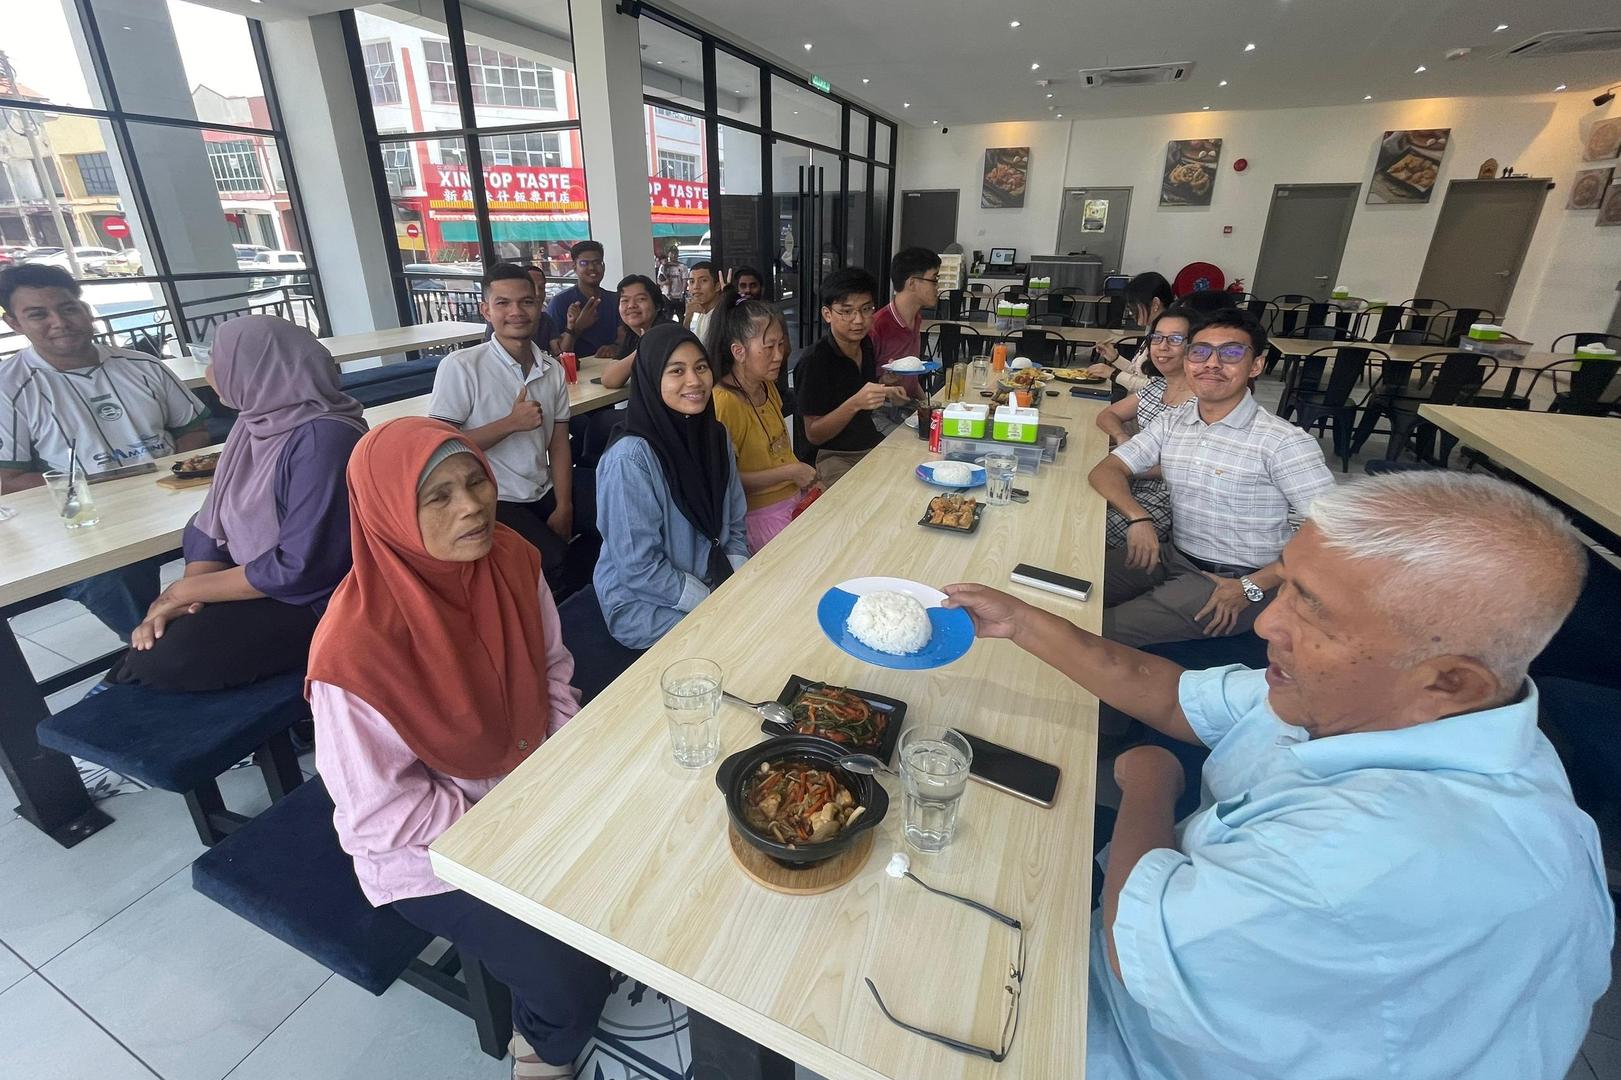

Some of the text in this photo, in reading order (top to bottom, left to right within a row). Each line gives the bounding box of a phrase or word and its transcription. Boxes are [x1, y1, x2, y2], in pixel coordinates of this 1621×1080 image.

[438, 170, 473, 188] XIN
[516, 172, 571, 190] TASTE
[668, 183, 709, 200] TASTE
